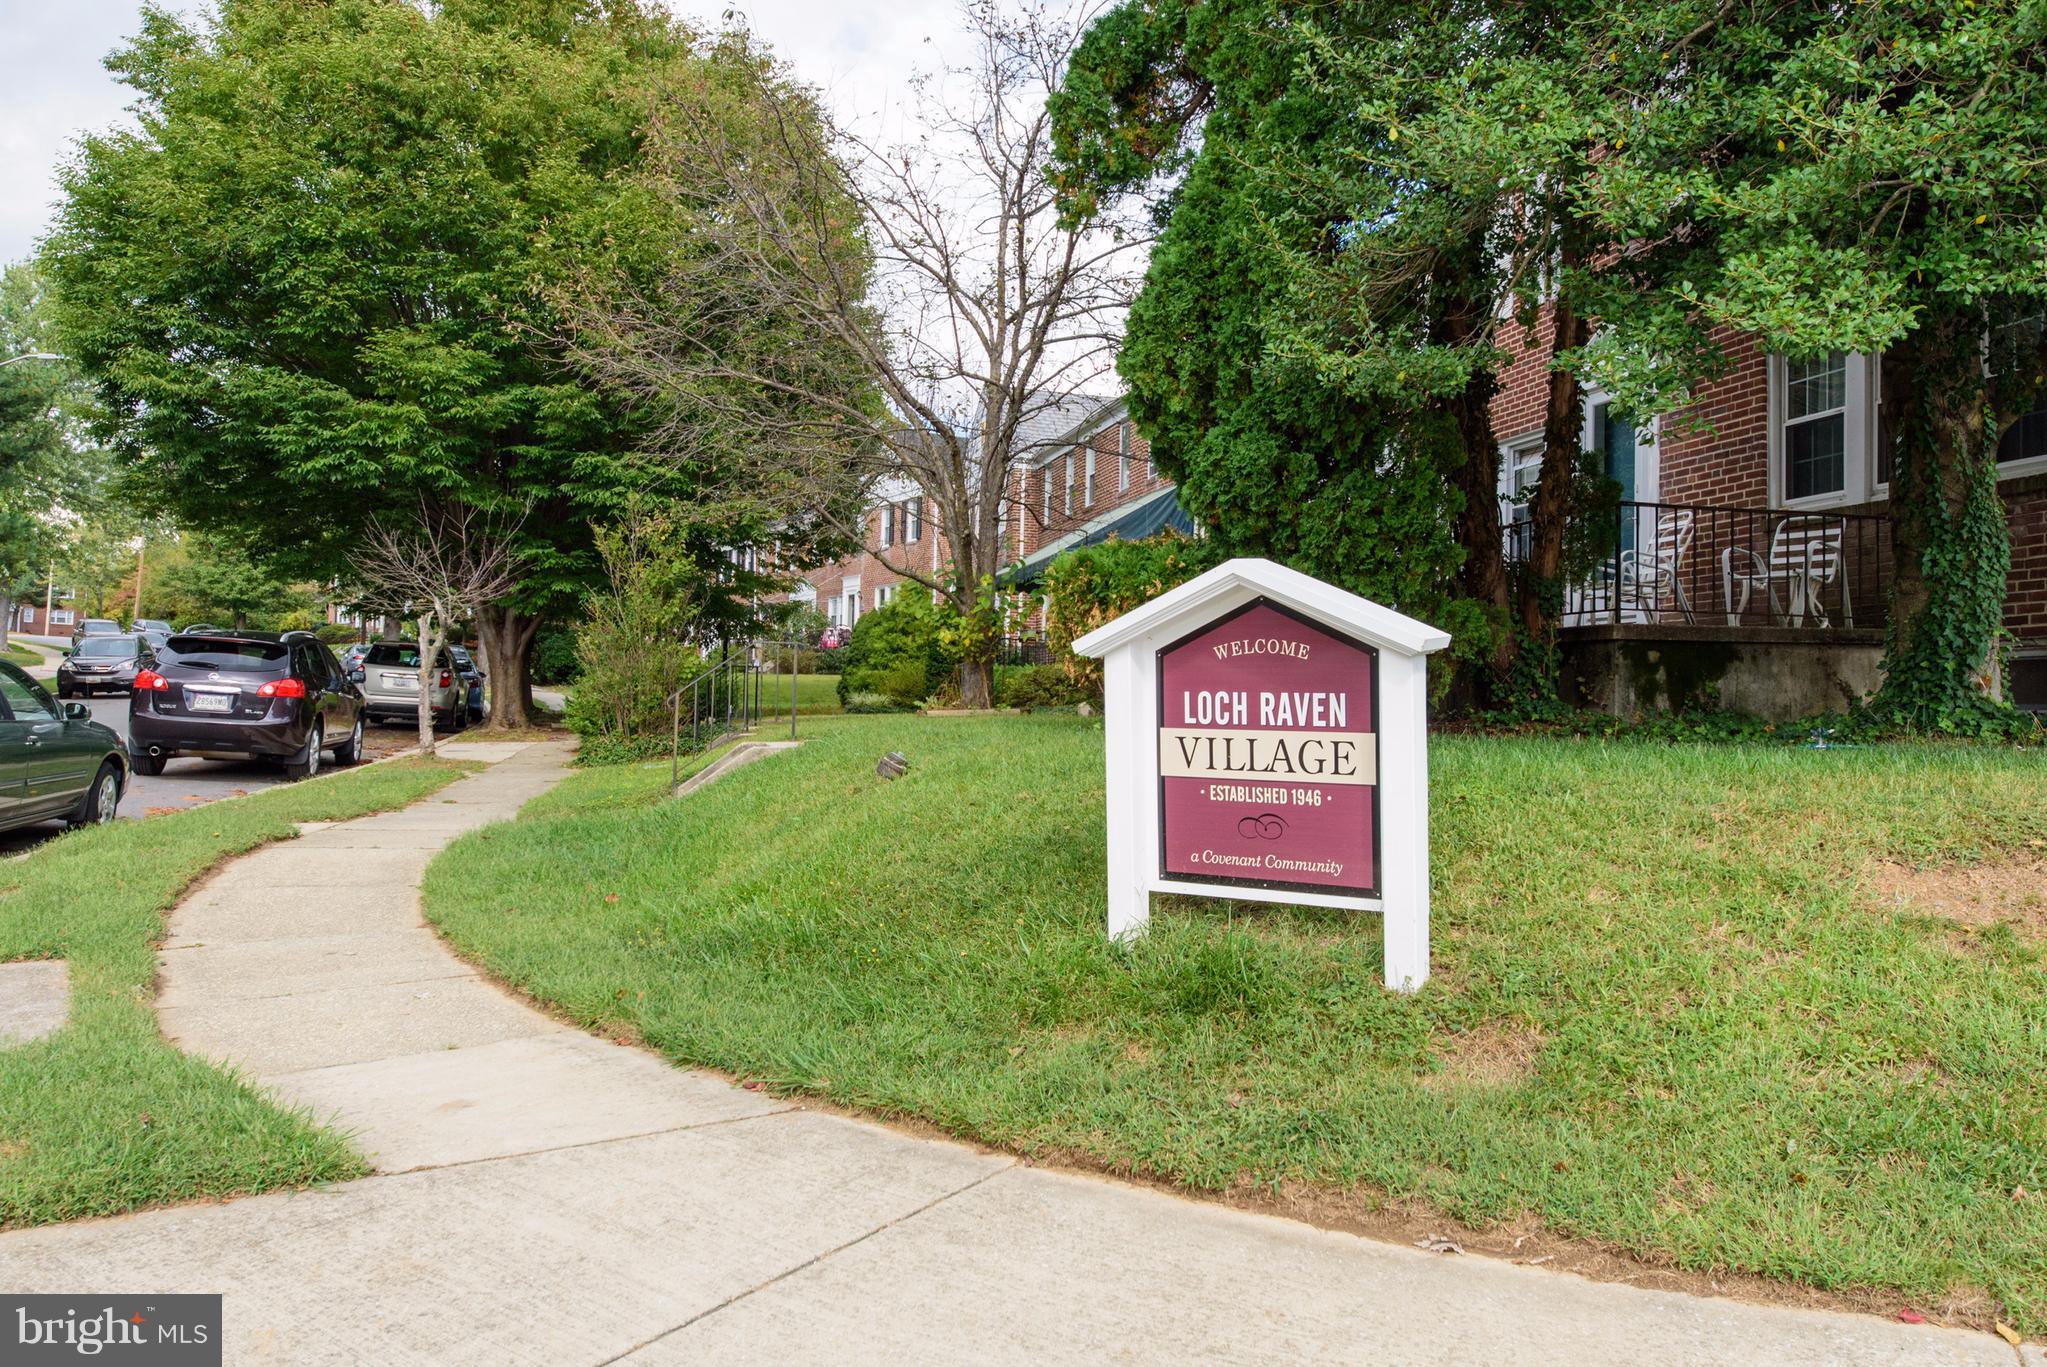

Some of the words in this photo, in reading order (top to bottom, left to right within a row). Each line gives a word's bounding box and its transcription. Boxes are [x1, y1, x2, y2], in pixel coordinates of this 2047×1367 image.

[1213, 638, 1311, 660] WELCOME
[1184, 690, 1248, 725] LOCH
[1260, 692, 1346, 728] RAVEN
[1175, 736, 1358, 776] VILLAGE
[1210, 785, 1287, 804] ESTABLISHED
[1291, 789, 1322, 807] 1946
[1190, 852, 1199, 863] a
[1202, 850, 1261, 868] Covenant
[1265, 854, 1344, 876] Community
